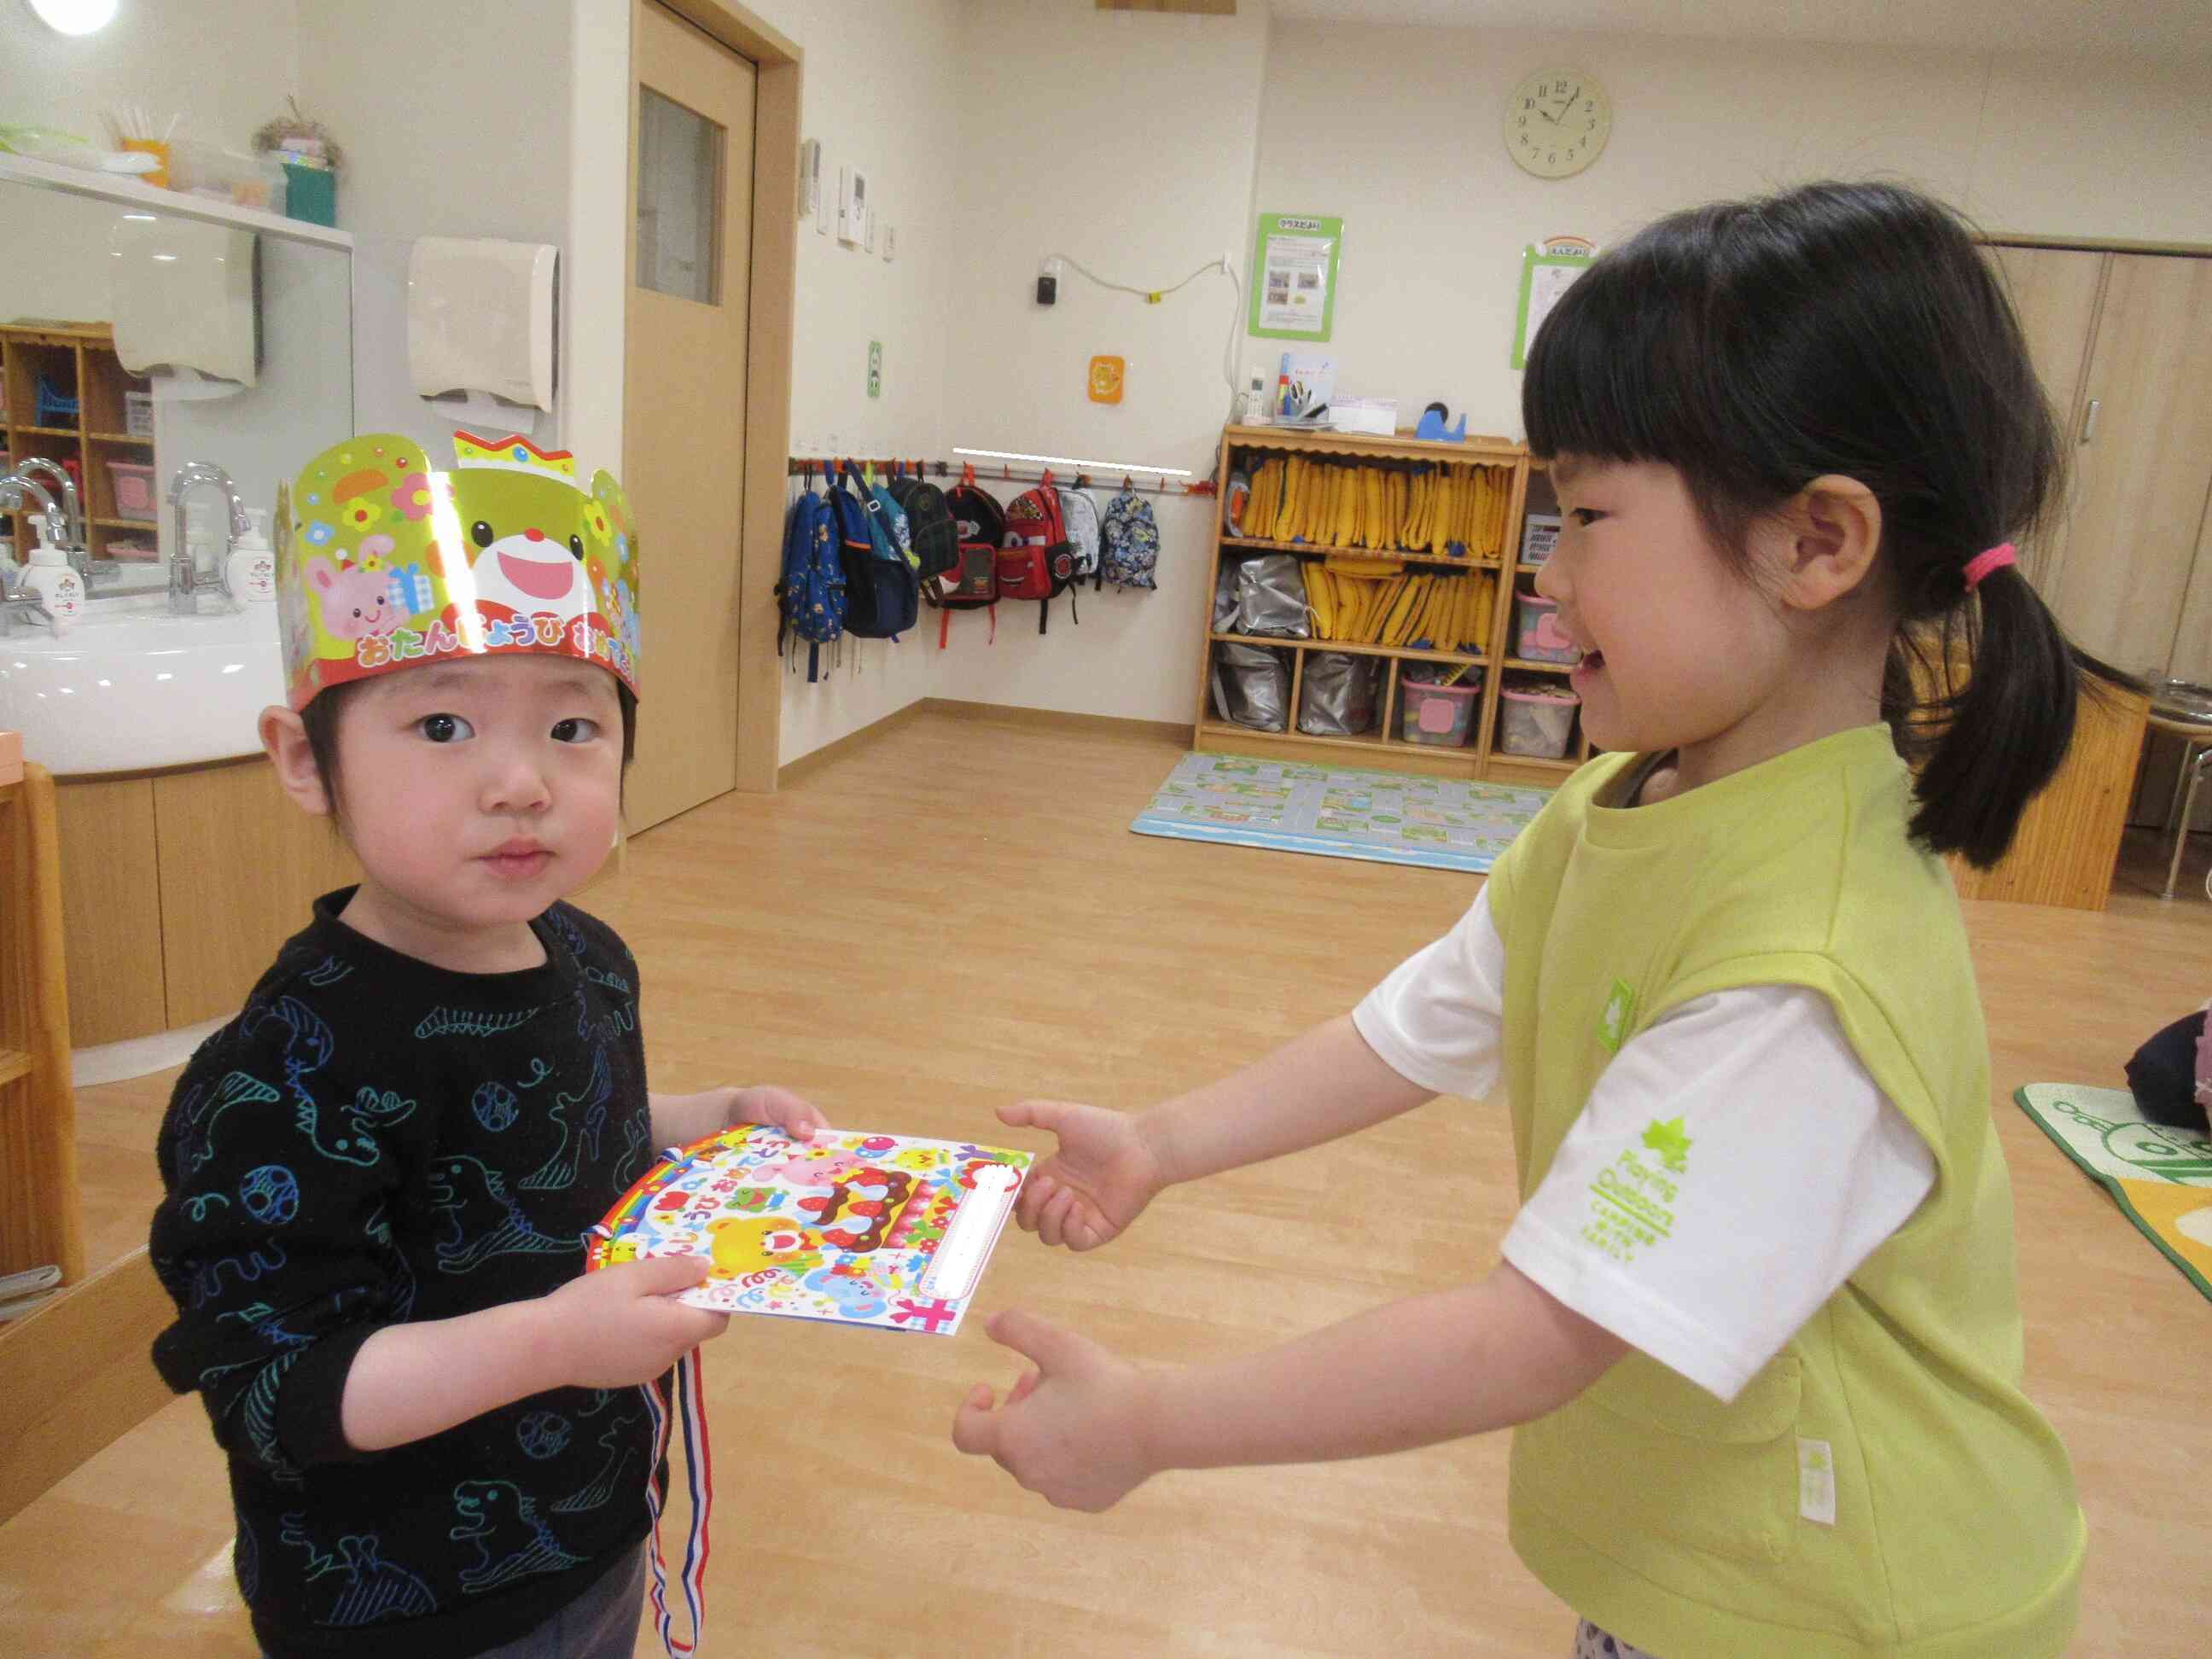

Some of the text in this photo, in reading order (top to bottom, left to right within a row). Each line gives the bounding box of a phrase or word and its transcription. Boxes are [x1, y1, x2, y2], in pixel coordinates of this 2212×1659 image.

[1538, 84, 1548, 97] 11
[1555, 80, 1570, 94] 12
[1524, 97, 1535, 109] 10
[1584, 100, 1593, 112] 2
[1518, 115, 1527, 128] 9
[1587, 118, 1596, 130] 3
[1521, 133, 1529, 146] 8
[1579, 136, 1587, 148] 4
[1532, 146, 1541, 160] 7
[1548, 153, 1557, 164] 6
[1566, 148, 1575, 160] 5
[1615, 1148, 1679, 1203] Playing
